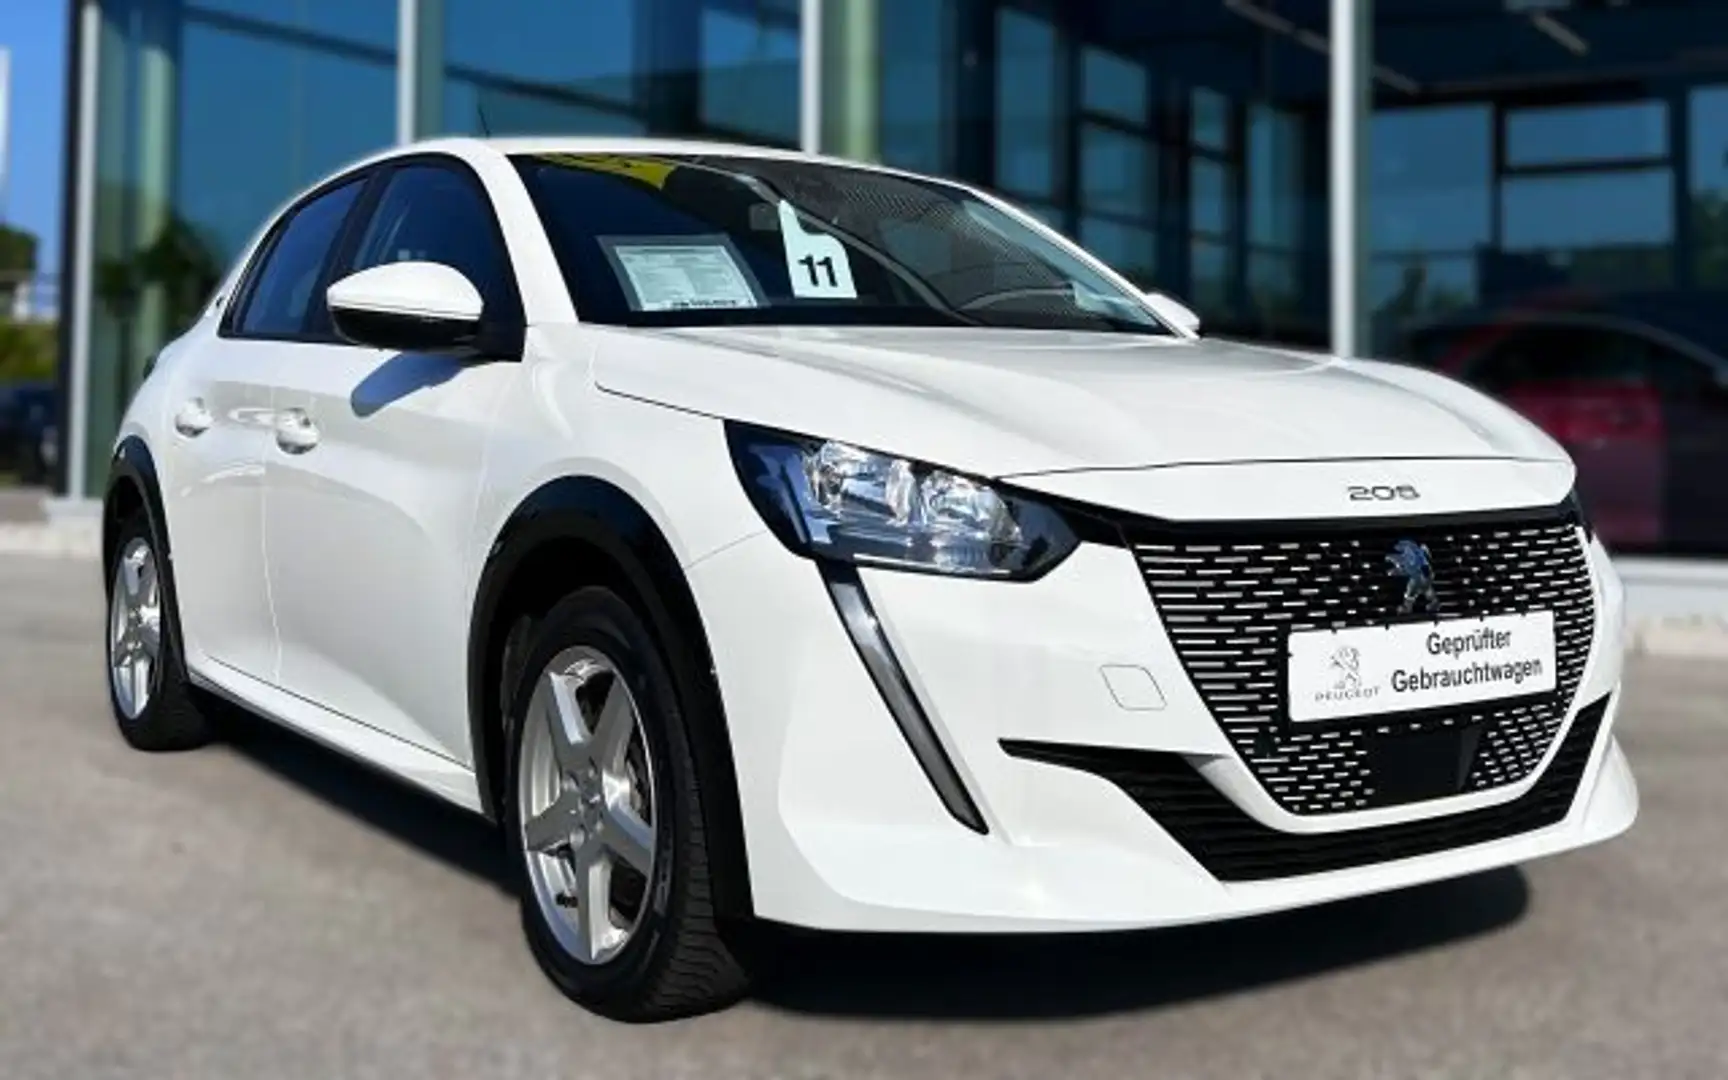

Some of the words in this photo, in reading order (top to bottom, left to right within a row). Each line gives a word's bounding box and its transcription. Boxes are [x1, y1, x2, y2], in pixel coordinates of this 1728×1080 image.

[798, 255, 838, 287] 11
[1426, 626, 1512, 659] Geprüfter
[1390, 658, 1543, 693] Gebrauchtwagen
[1314, 686, 1381, 702] PEUGEOT
